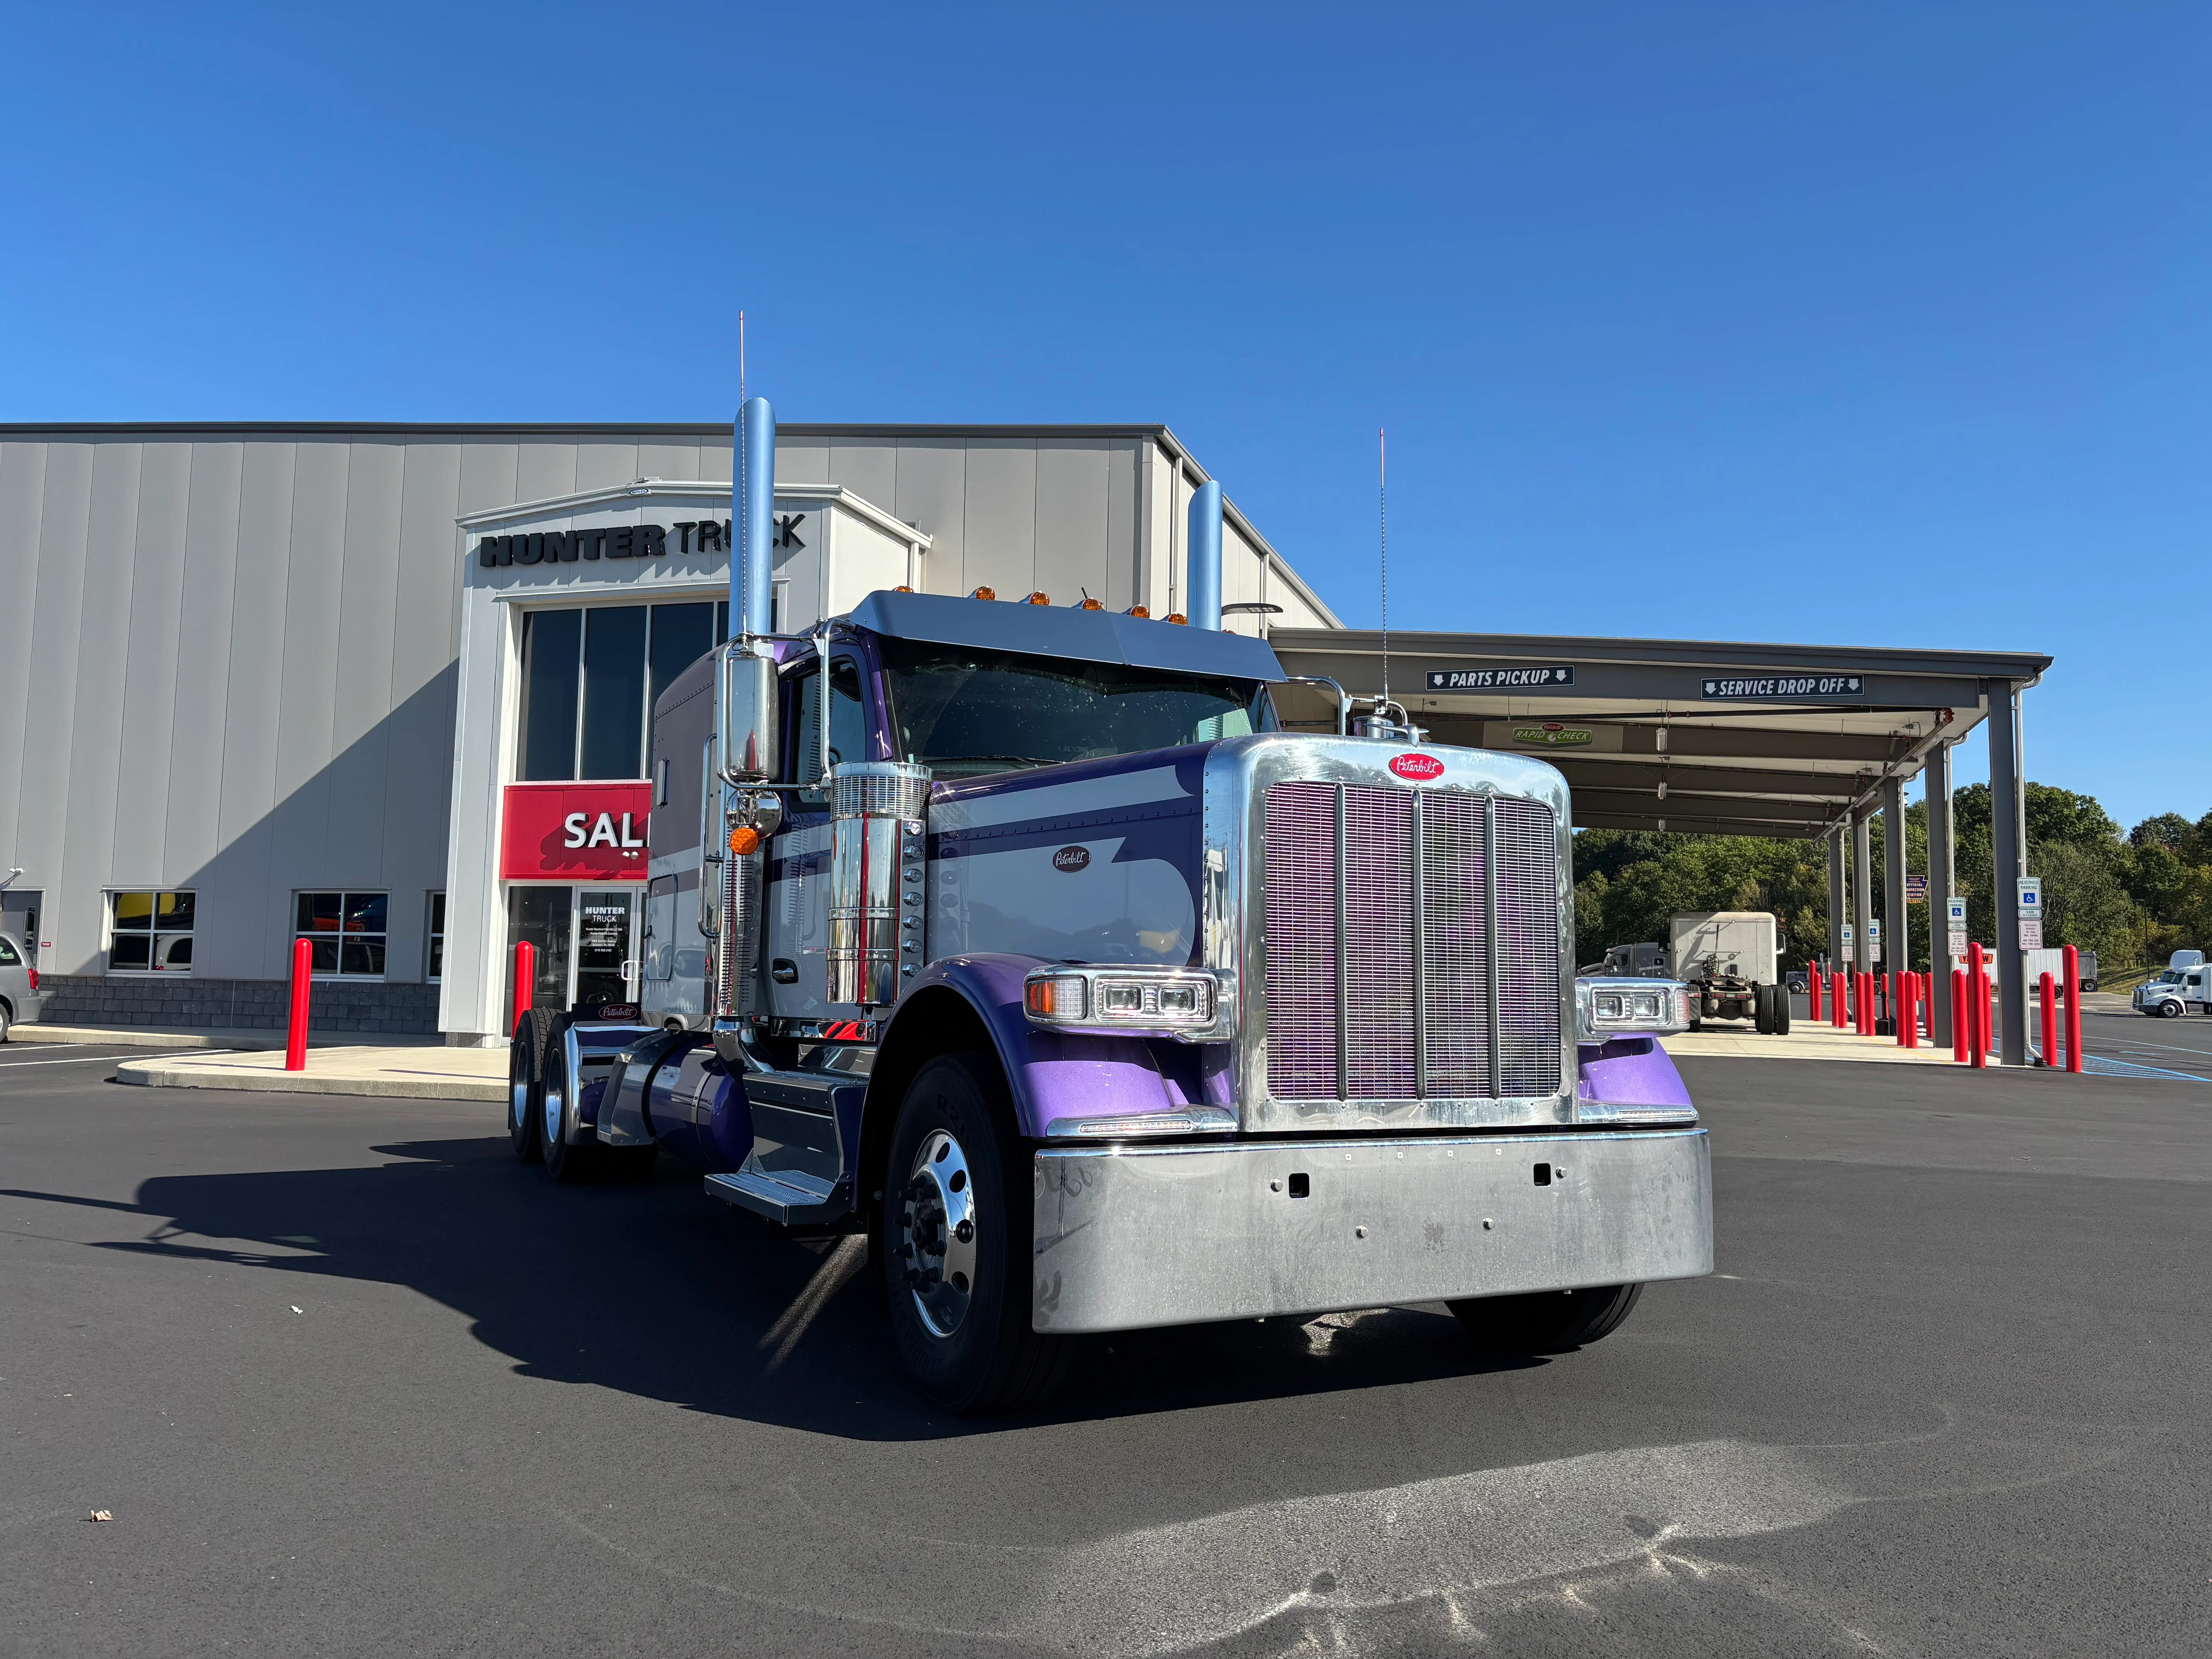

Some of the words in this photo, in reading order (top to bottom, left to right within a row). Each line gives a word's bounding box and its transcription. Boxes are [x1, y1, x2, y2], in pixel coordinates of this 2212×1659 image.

[480, 525, 666, 567] HUNTER
[673, 514, 806, 554] TRK
[1449, 672, 1492, 687] PARTS
[1496, 670, 1549, 685] PICKUP
[1719, 680, 1774, 696] SERVICE
[1778, 679, 1815, 694] DROP
[1819, 678, 1845, 693] OFF
[1558, 732, 1590, 740] CHECK
[1397, 756, 1440, 773] Peterbilt
[1056, 852, 1086, 866] Peterbilt
[603, 1007, 635, 1017] Peterbilt
